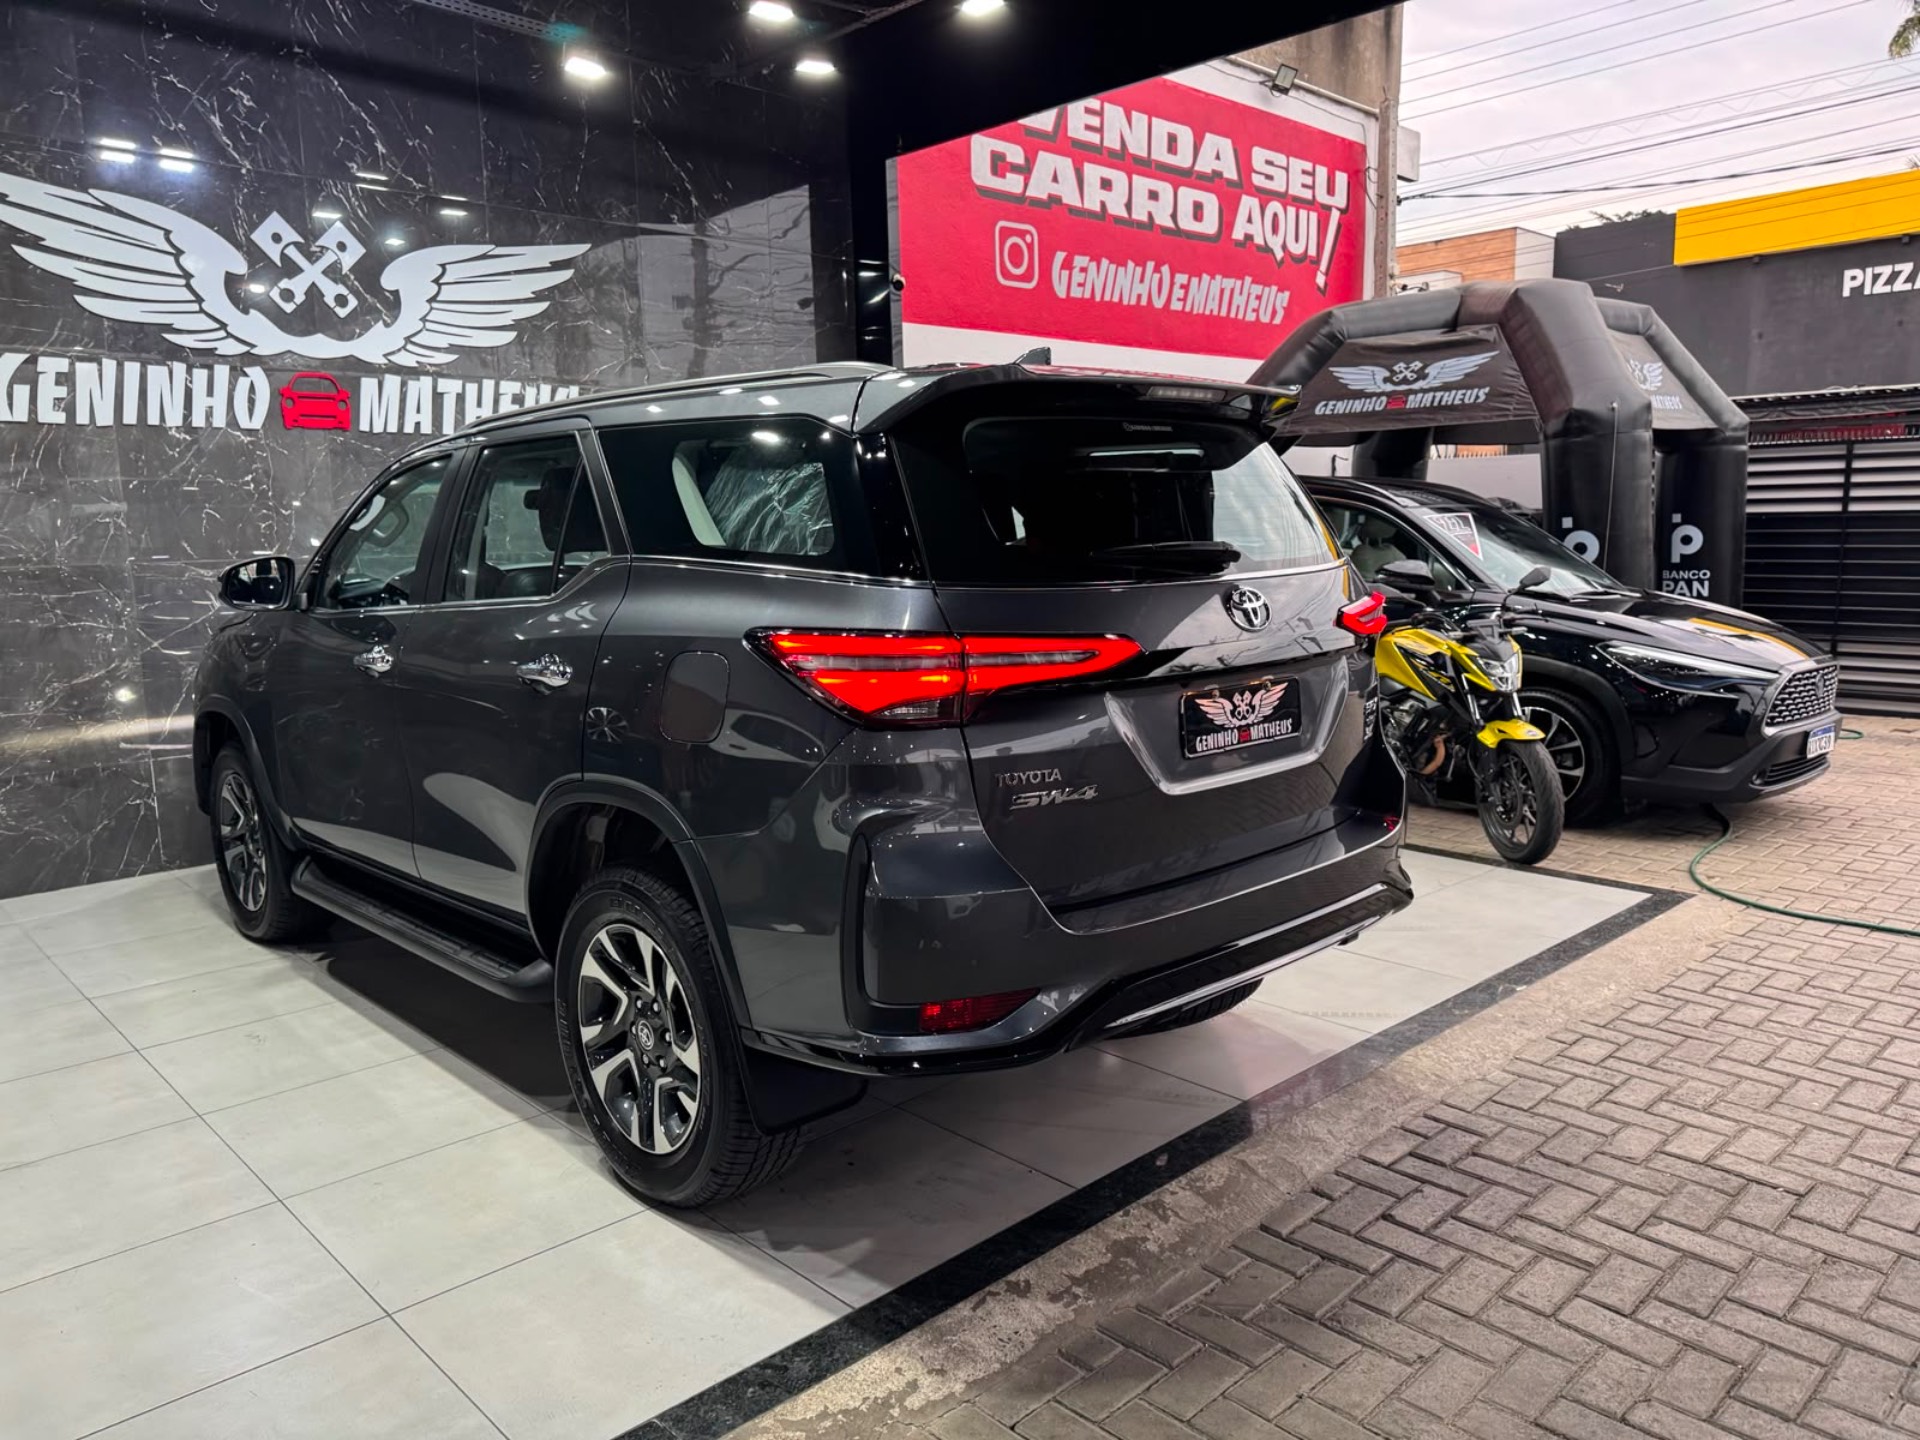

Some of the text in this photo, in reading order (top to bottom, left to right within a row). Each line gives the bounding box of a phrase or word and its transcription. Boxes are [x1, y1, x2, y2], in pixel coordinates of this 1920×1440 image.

[1252, 146, 1348, 209] SEU
[971, 134, 1341, 289] CARRO AQUI!
[0, 352, 271, 430] GENINHO
[1314, 387, 1490, 416] GENINHO MATHEUS
[1662, 569, 1711, 580] BANCO
[1662, 580, 1710, 598] PAN
[1195, 718, 1292, 752] GENINHO MATHEUS
[995, 768, 1062, 788] TOYOTA
[1009, 784, 1098, 810] SW4
